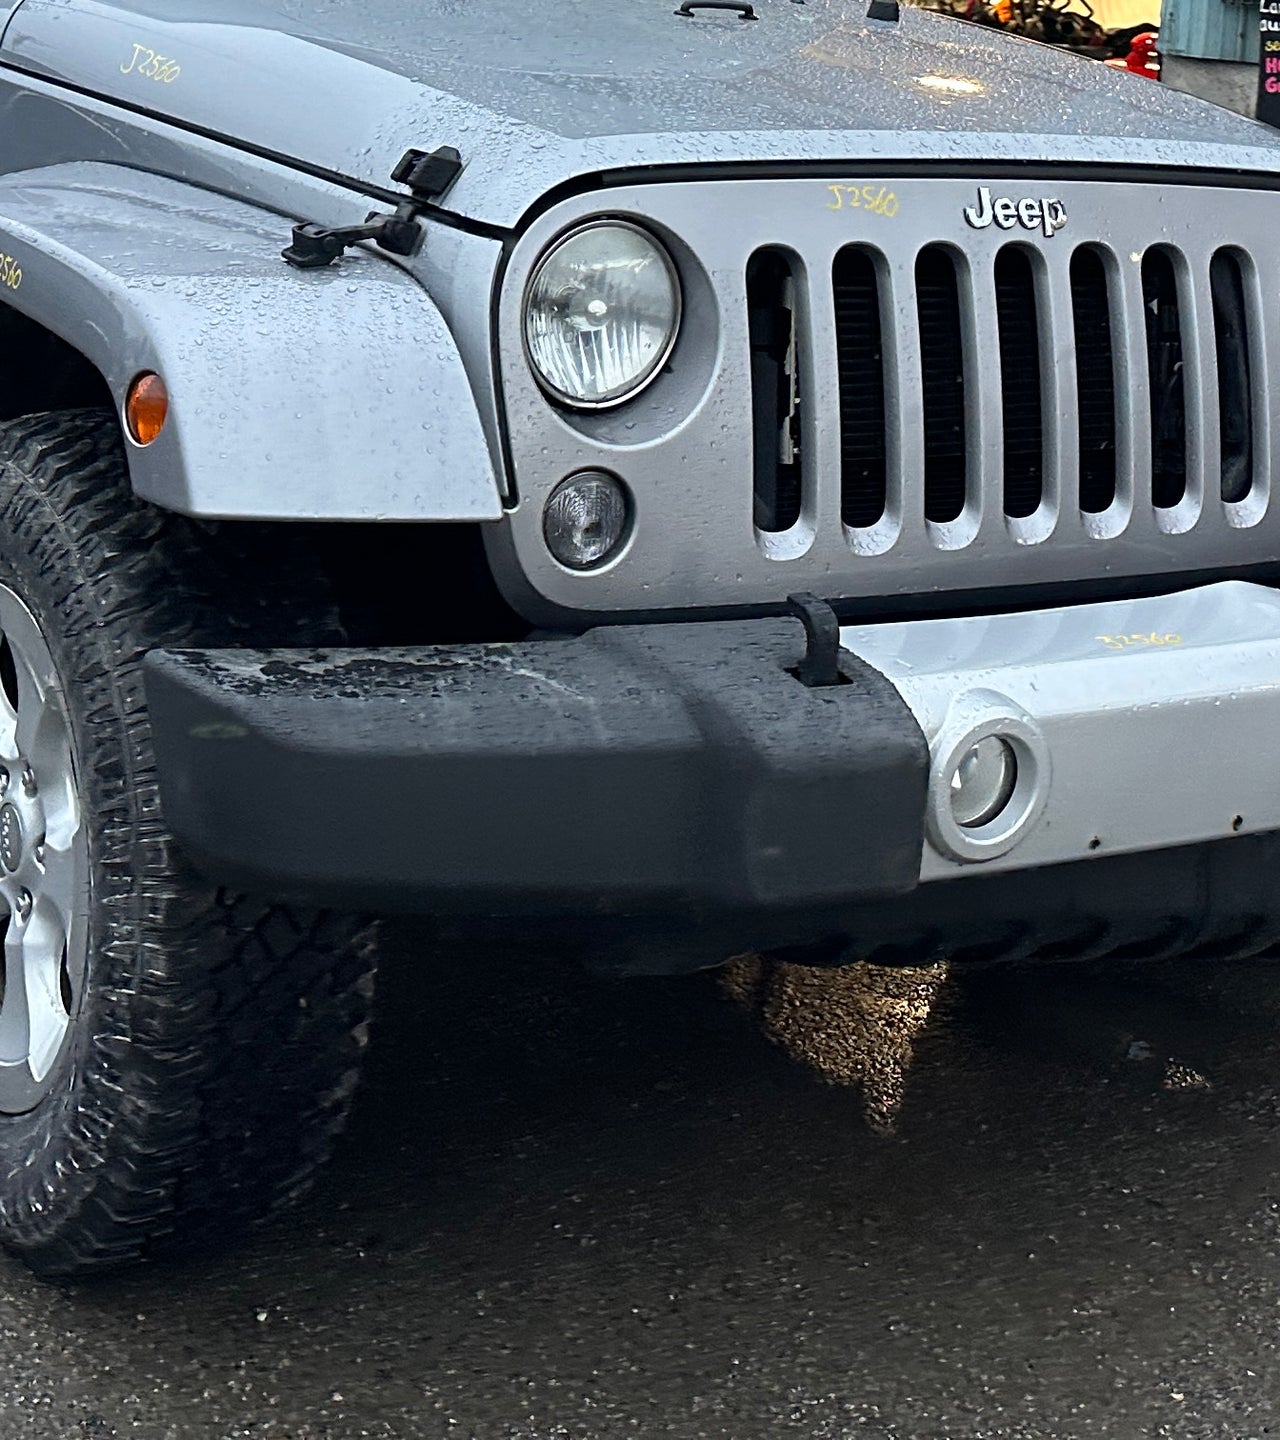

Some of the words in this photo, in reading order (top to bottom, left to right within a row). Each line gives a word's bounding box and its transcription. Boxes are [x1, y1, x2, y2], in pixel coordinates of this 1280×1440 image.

[120, 43, 181, 83] J2560
[826, 184, 899, 217] J2560
[963, 185, 1068, 238] Jeep
